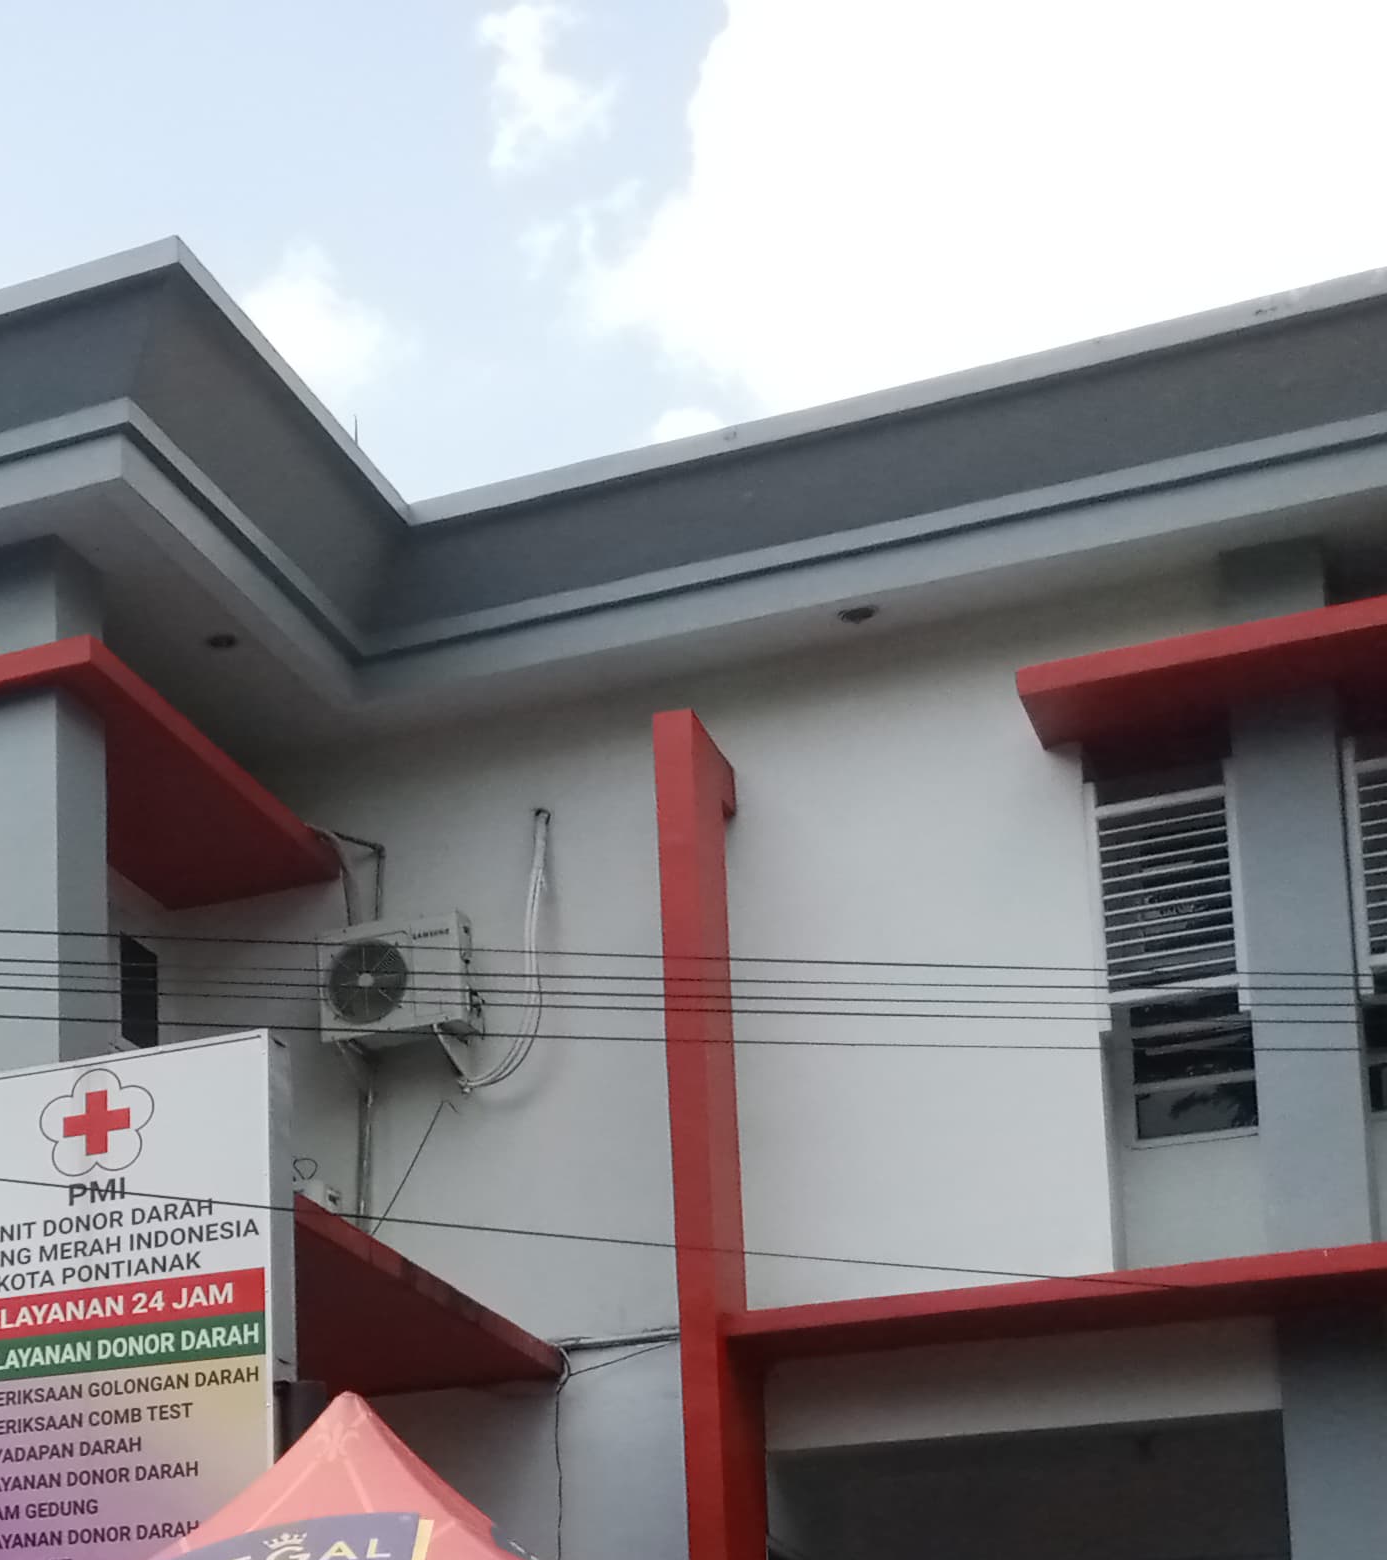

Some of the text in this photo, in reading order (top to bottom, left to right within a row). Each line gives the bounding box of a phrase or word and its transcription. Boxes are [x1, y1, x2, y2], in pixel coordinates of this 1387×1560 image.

[68, 1177, 126, 1206] PMI
[43, 1211, 123, 1238] DONOR
[131, 1198, 214, 1225] DARAH
[39, 1237, 121, 1263] MERAH
[130, 1218, 260, 1251] INDONESIA
[62, 1251, 201, 1285] PONTIANAK
[132, 1291, 164, 1315] 24
[172, 1282, 234, 1310] JAM
[97, 1332, 175, 1360] DONOR
[181, 1323, 260, 1351] DARAH
[88, 1373, 189, 1398] GOLONGAN
[194, 1366, 260, 1388] DARAH
[88, 1404, 142, 1427] COMB
[146, 1402, 194, 1422] TEST
[79, 1437, 142, 1457] DARAH
[67, 1465, 130, 1487] DONOR
[135, 1461, 199, 1482] DARAH
[26, 1499, 99, 1520] GEDUNG
[67, 1524, 131, 1546] DONOR
[136, 1519, 200, 1541] DARAH
